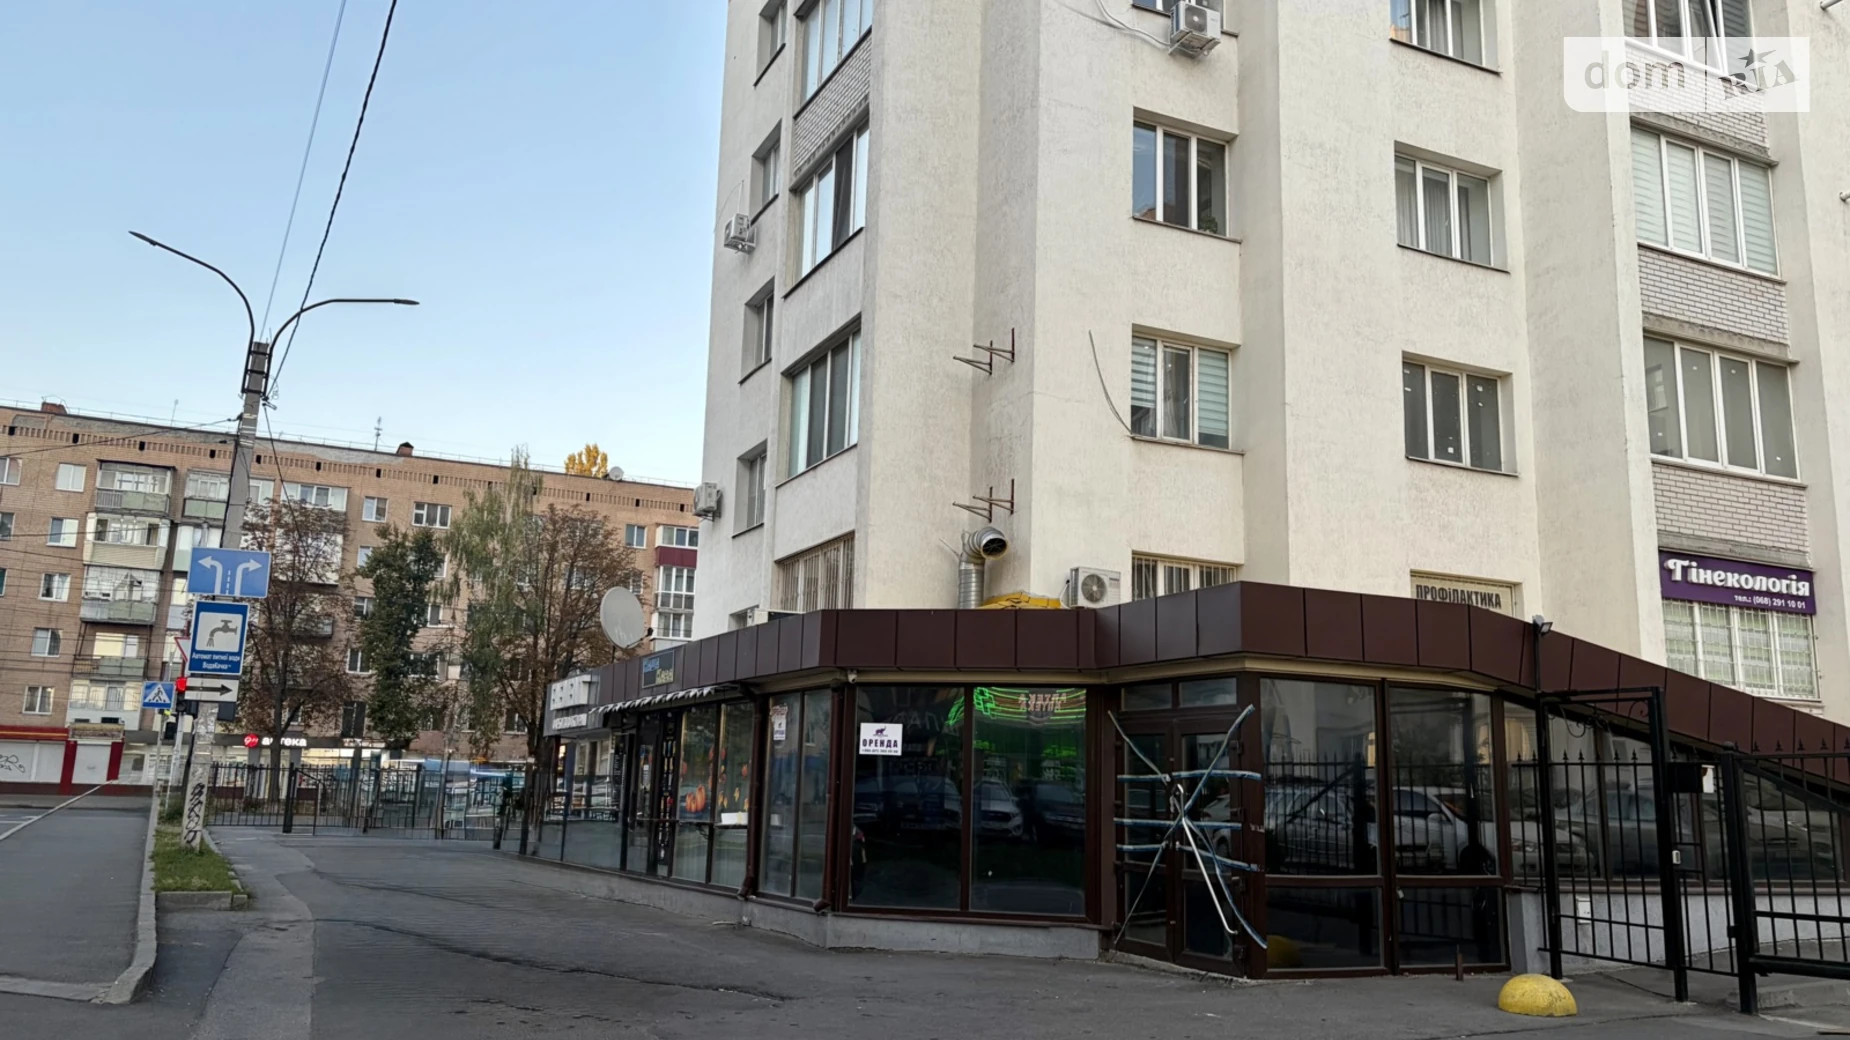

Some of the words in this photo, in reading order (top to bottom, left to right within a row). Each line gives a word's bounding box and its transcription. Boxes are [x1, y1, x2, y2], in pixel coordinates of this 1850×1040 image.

[1664, 558, 1810, 597] Гінекологія
[1752, 595, 1771, 607] (068)
[1772, 597, 1786, 607] 291
[1787, 599, 1796, 608] 10
[1796, 601, 1806, 609] 01
[862, 738, 898, 748] ОРЕНДА
